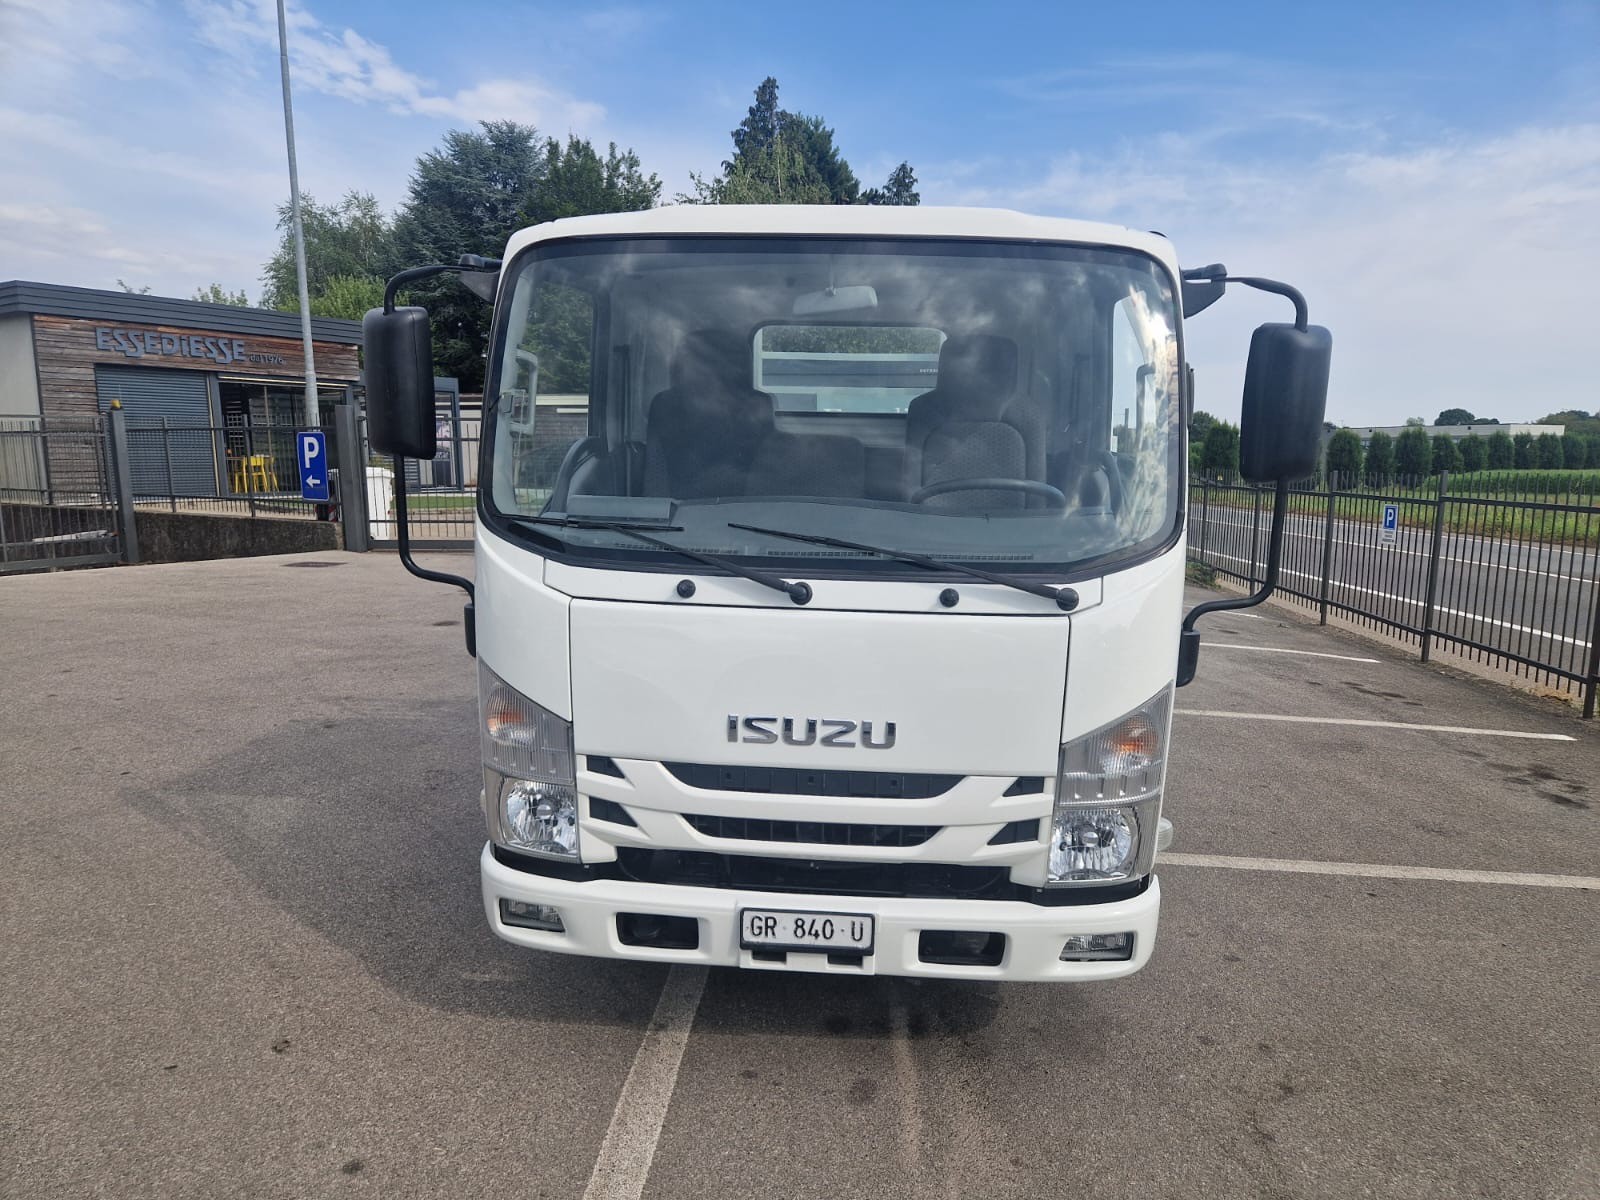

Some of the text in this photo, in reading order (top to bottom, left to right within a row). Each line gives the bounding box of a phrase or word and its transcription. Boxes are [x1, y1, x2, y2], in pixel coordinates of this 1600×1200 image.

[303, 436, 320, 469] P
[1386, 508, 1394, 527] P
[727, 713, 897, 750] ISUZU
[750, 916, 864, 942] GR 840 U
